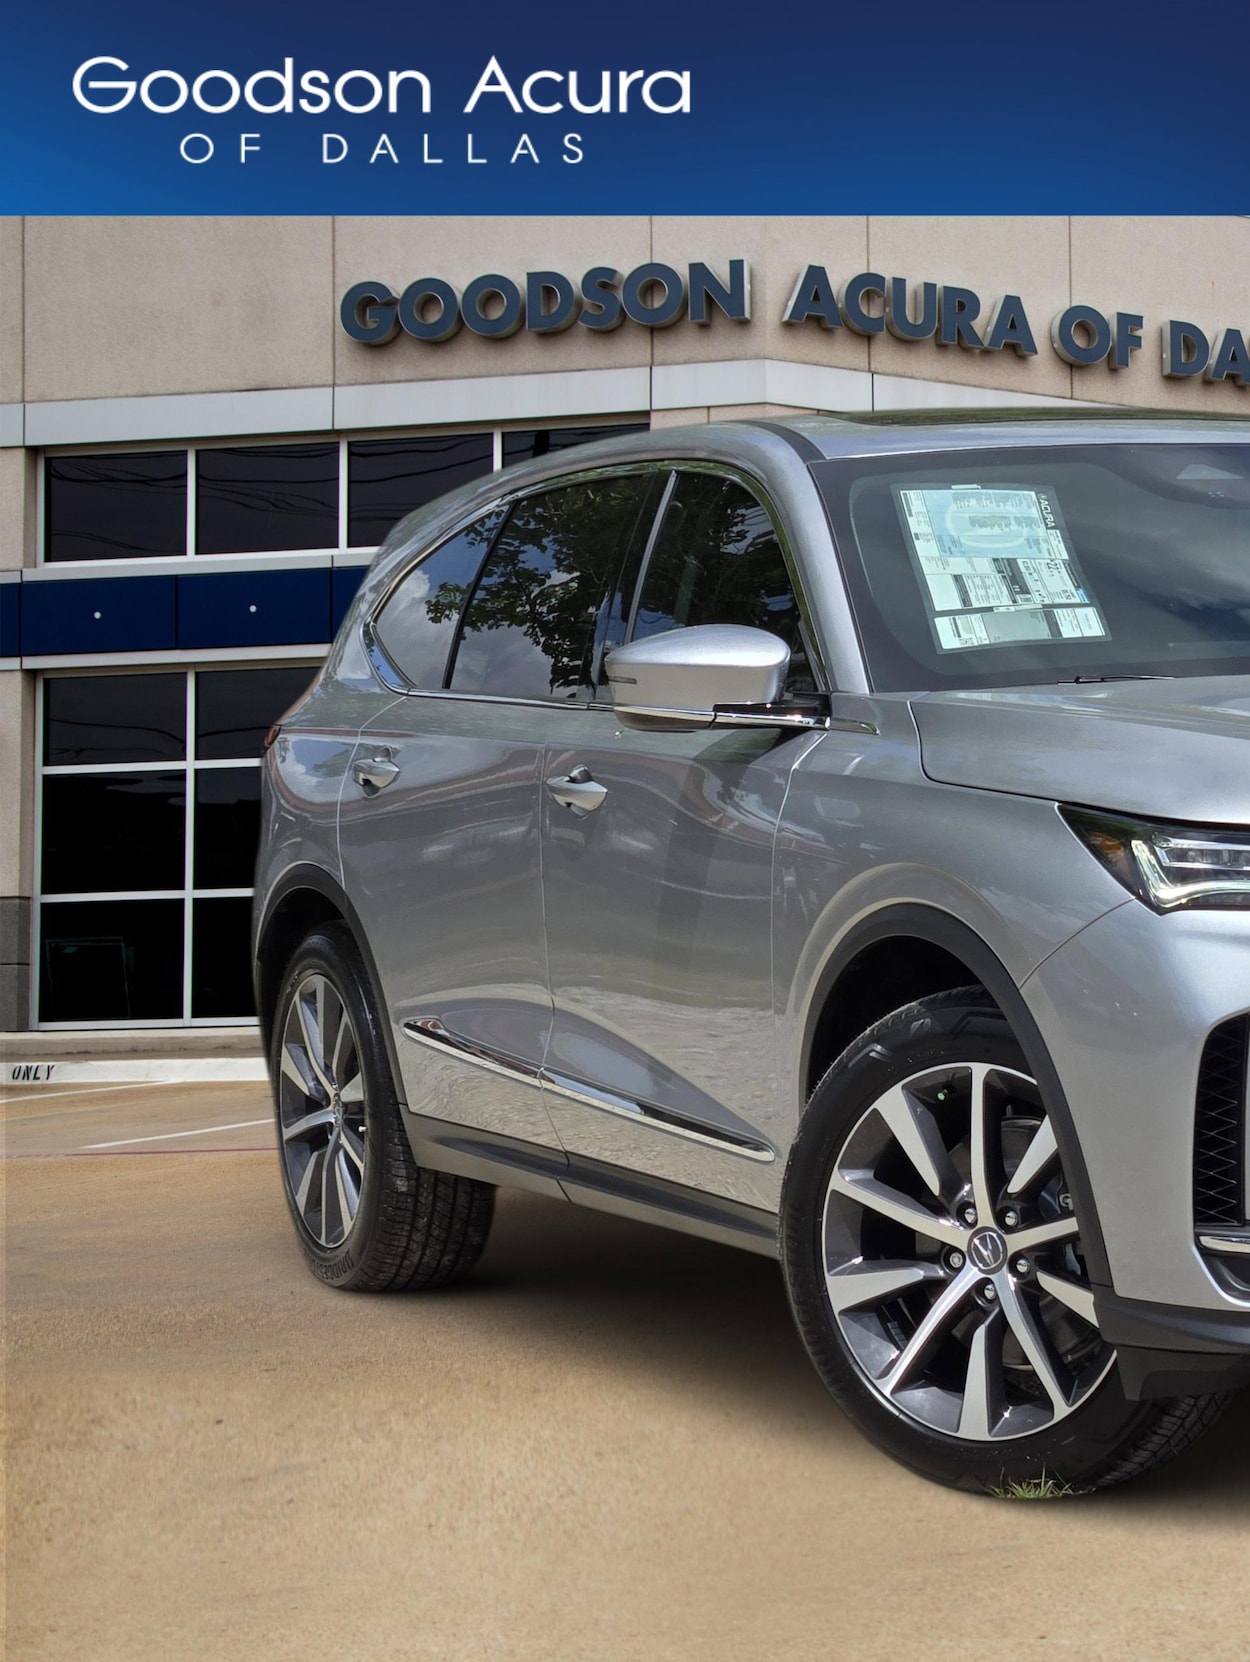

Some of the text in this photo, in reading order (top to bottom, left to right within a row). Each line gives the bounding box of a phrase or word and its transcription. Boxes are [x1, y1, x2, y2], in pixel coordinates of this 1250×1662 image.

[340, 258, 751, 346] GOODSON
[782, 264, 1039, 356] ACURA
[1051, 304, 1144, 369] OF
[1039, 499, 1056, 529] ACURA
[12, 1064, 55, 1081] ONLY
